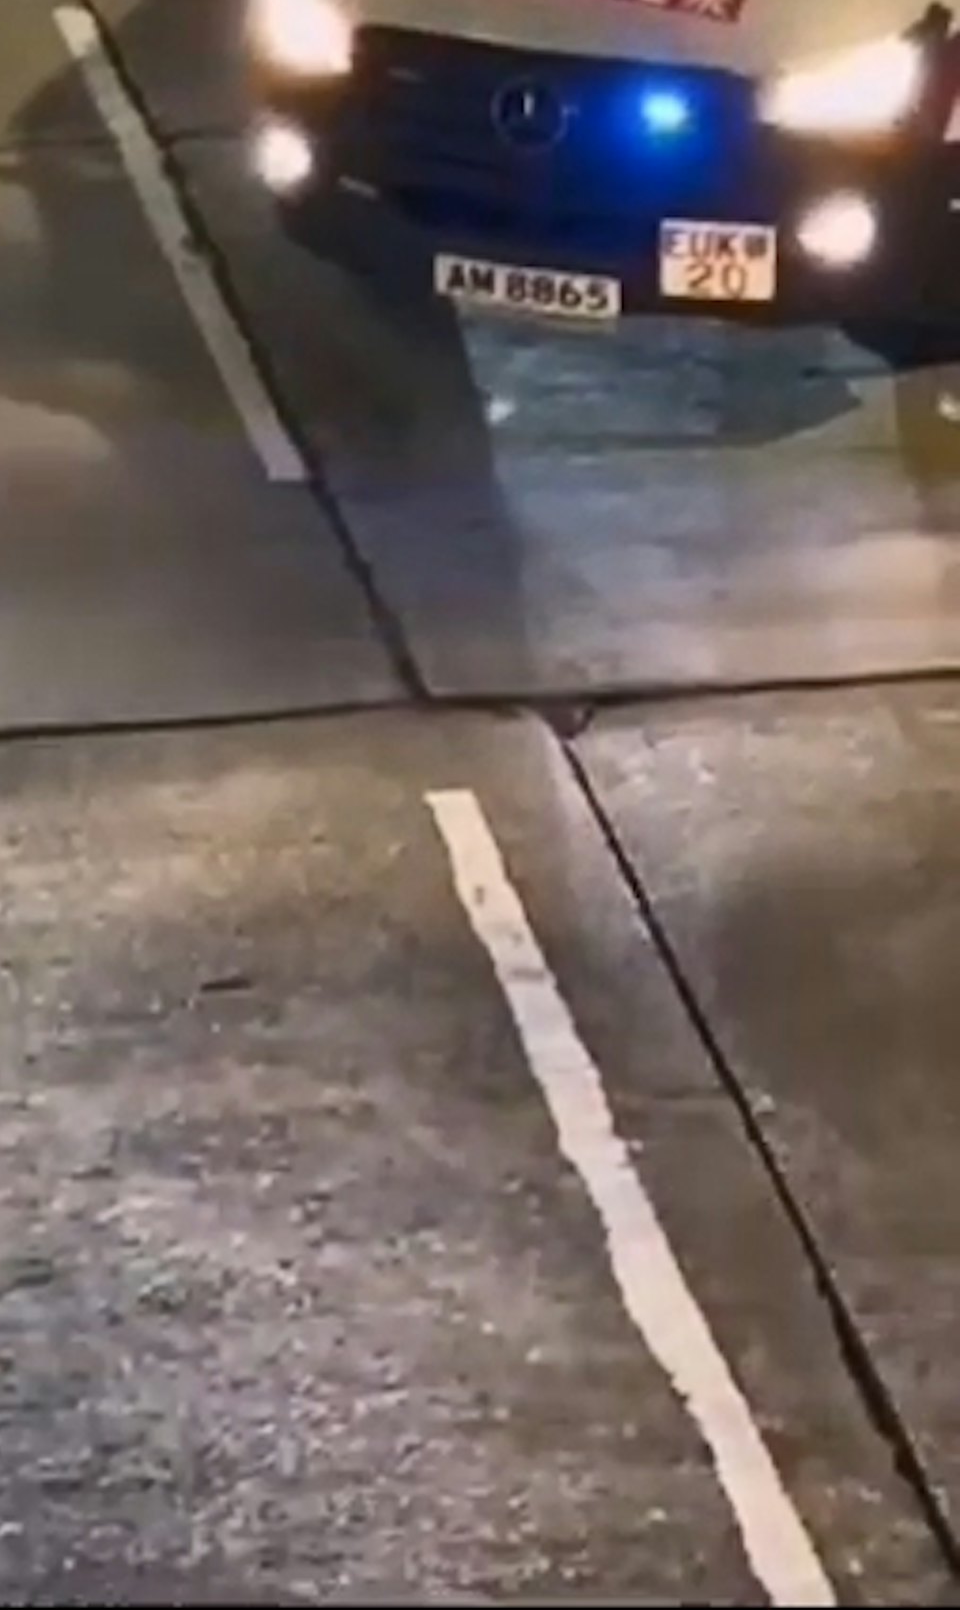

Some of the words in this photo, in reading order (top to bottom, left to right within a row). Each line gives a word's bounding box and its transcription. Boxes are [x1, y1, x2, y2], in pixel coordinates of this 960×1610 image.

[447, 262, 495, 294] AM
[506, 270, 609, 312] 8865
[685, 263, 748, 299] 20
